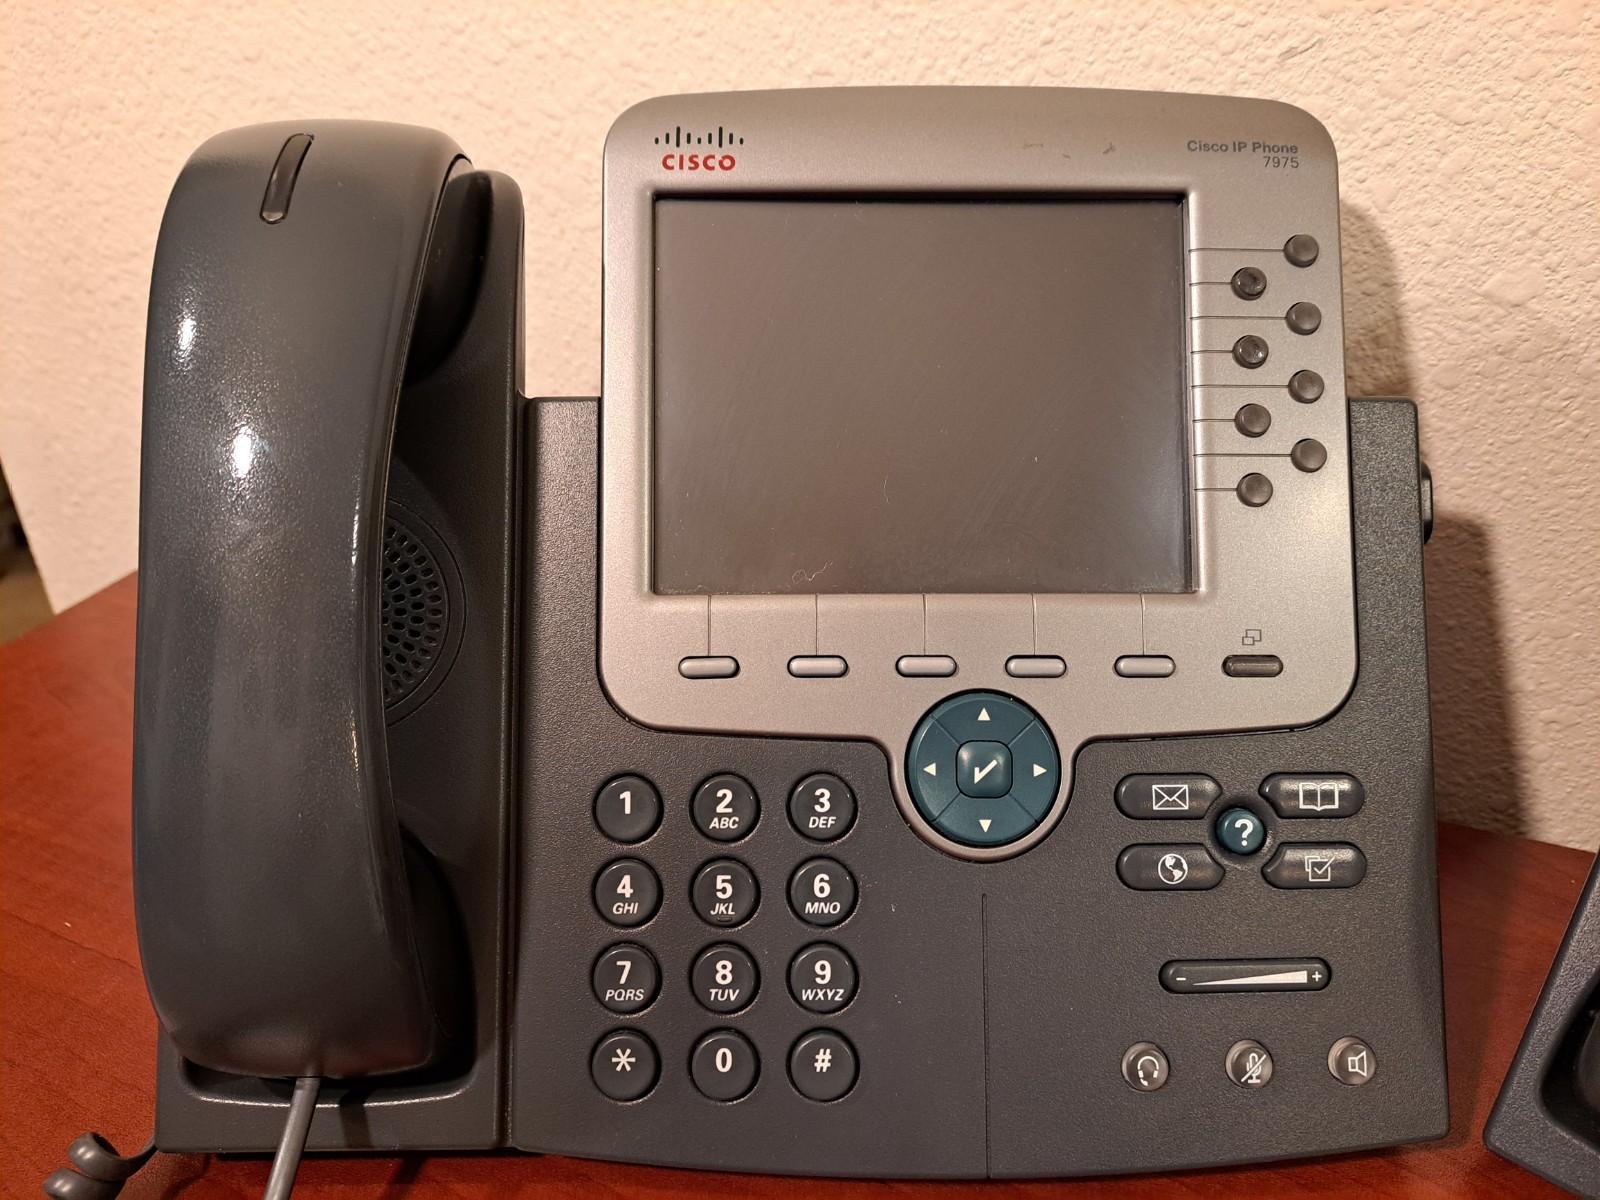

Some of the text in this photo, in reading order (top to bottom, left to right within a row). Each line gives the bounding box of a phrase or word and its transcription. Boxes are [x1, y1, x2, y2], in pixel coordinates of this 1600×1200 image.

[1187, 141, 1298, 153] Cisco IP Phone
[1263, 156, 1299, 168] 7975
[619, 791, 631, 814] 1
[716, 789, 733, 813] 2
[814, 788, 830, 812] 3
[709, 817, 739, 829] ABC
[809, 817, 836, 828] DEF
[616, 875, 633, 898] 4
[716, 875, 731, 899] 5
[813, 873, 830, 898] 6
[612, 903, 638, 915] GHI
[710, 903, 735, 914] JKL
[805, 902, 840, 914] MNO
[616, 961, 631, 984] 7
[715, 960, 732, 985] 8
[814, 960, 831, 985] 9
[605, 989, 644, 1001] PQRS
[709, 989, 739, 1001] TUV
[801, 989, 844, 1001] WXYZ
[715, 1048, 732, 1072] 0
[814, 1049, 831, 1072] #
